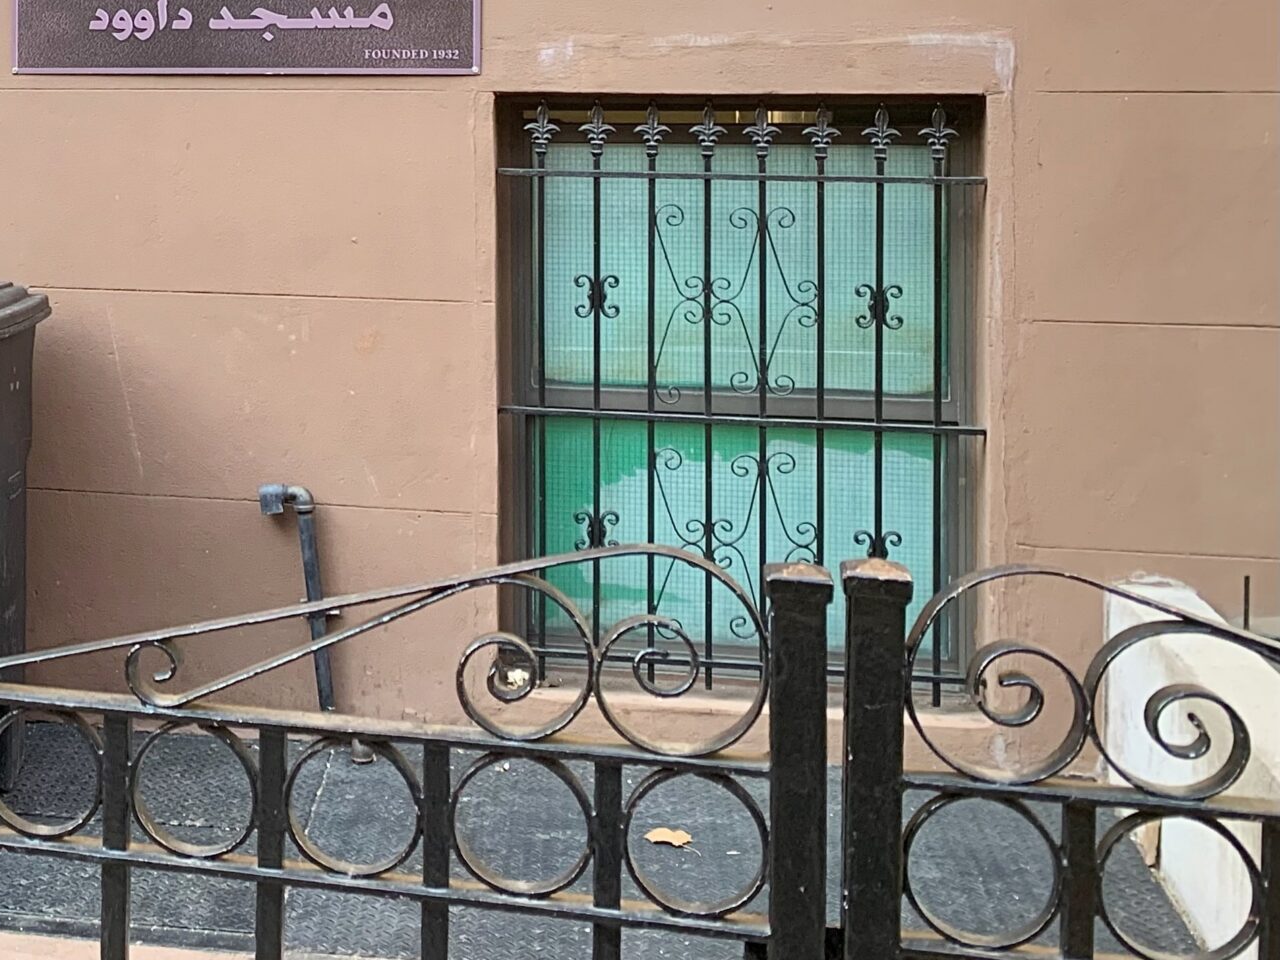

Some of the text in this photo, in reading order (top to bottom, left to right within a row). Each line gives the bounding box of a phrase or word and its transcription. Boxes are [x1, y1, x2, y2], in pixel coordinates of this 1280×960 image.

[209, 1, 394, 41] مسجد
[364, 49, 459, 60] FOUNDED 1932
